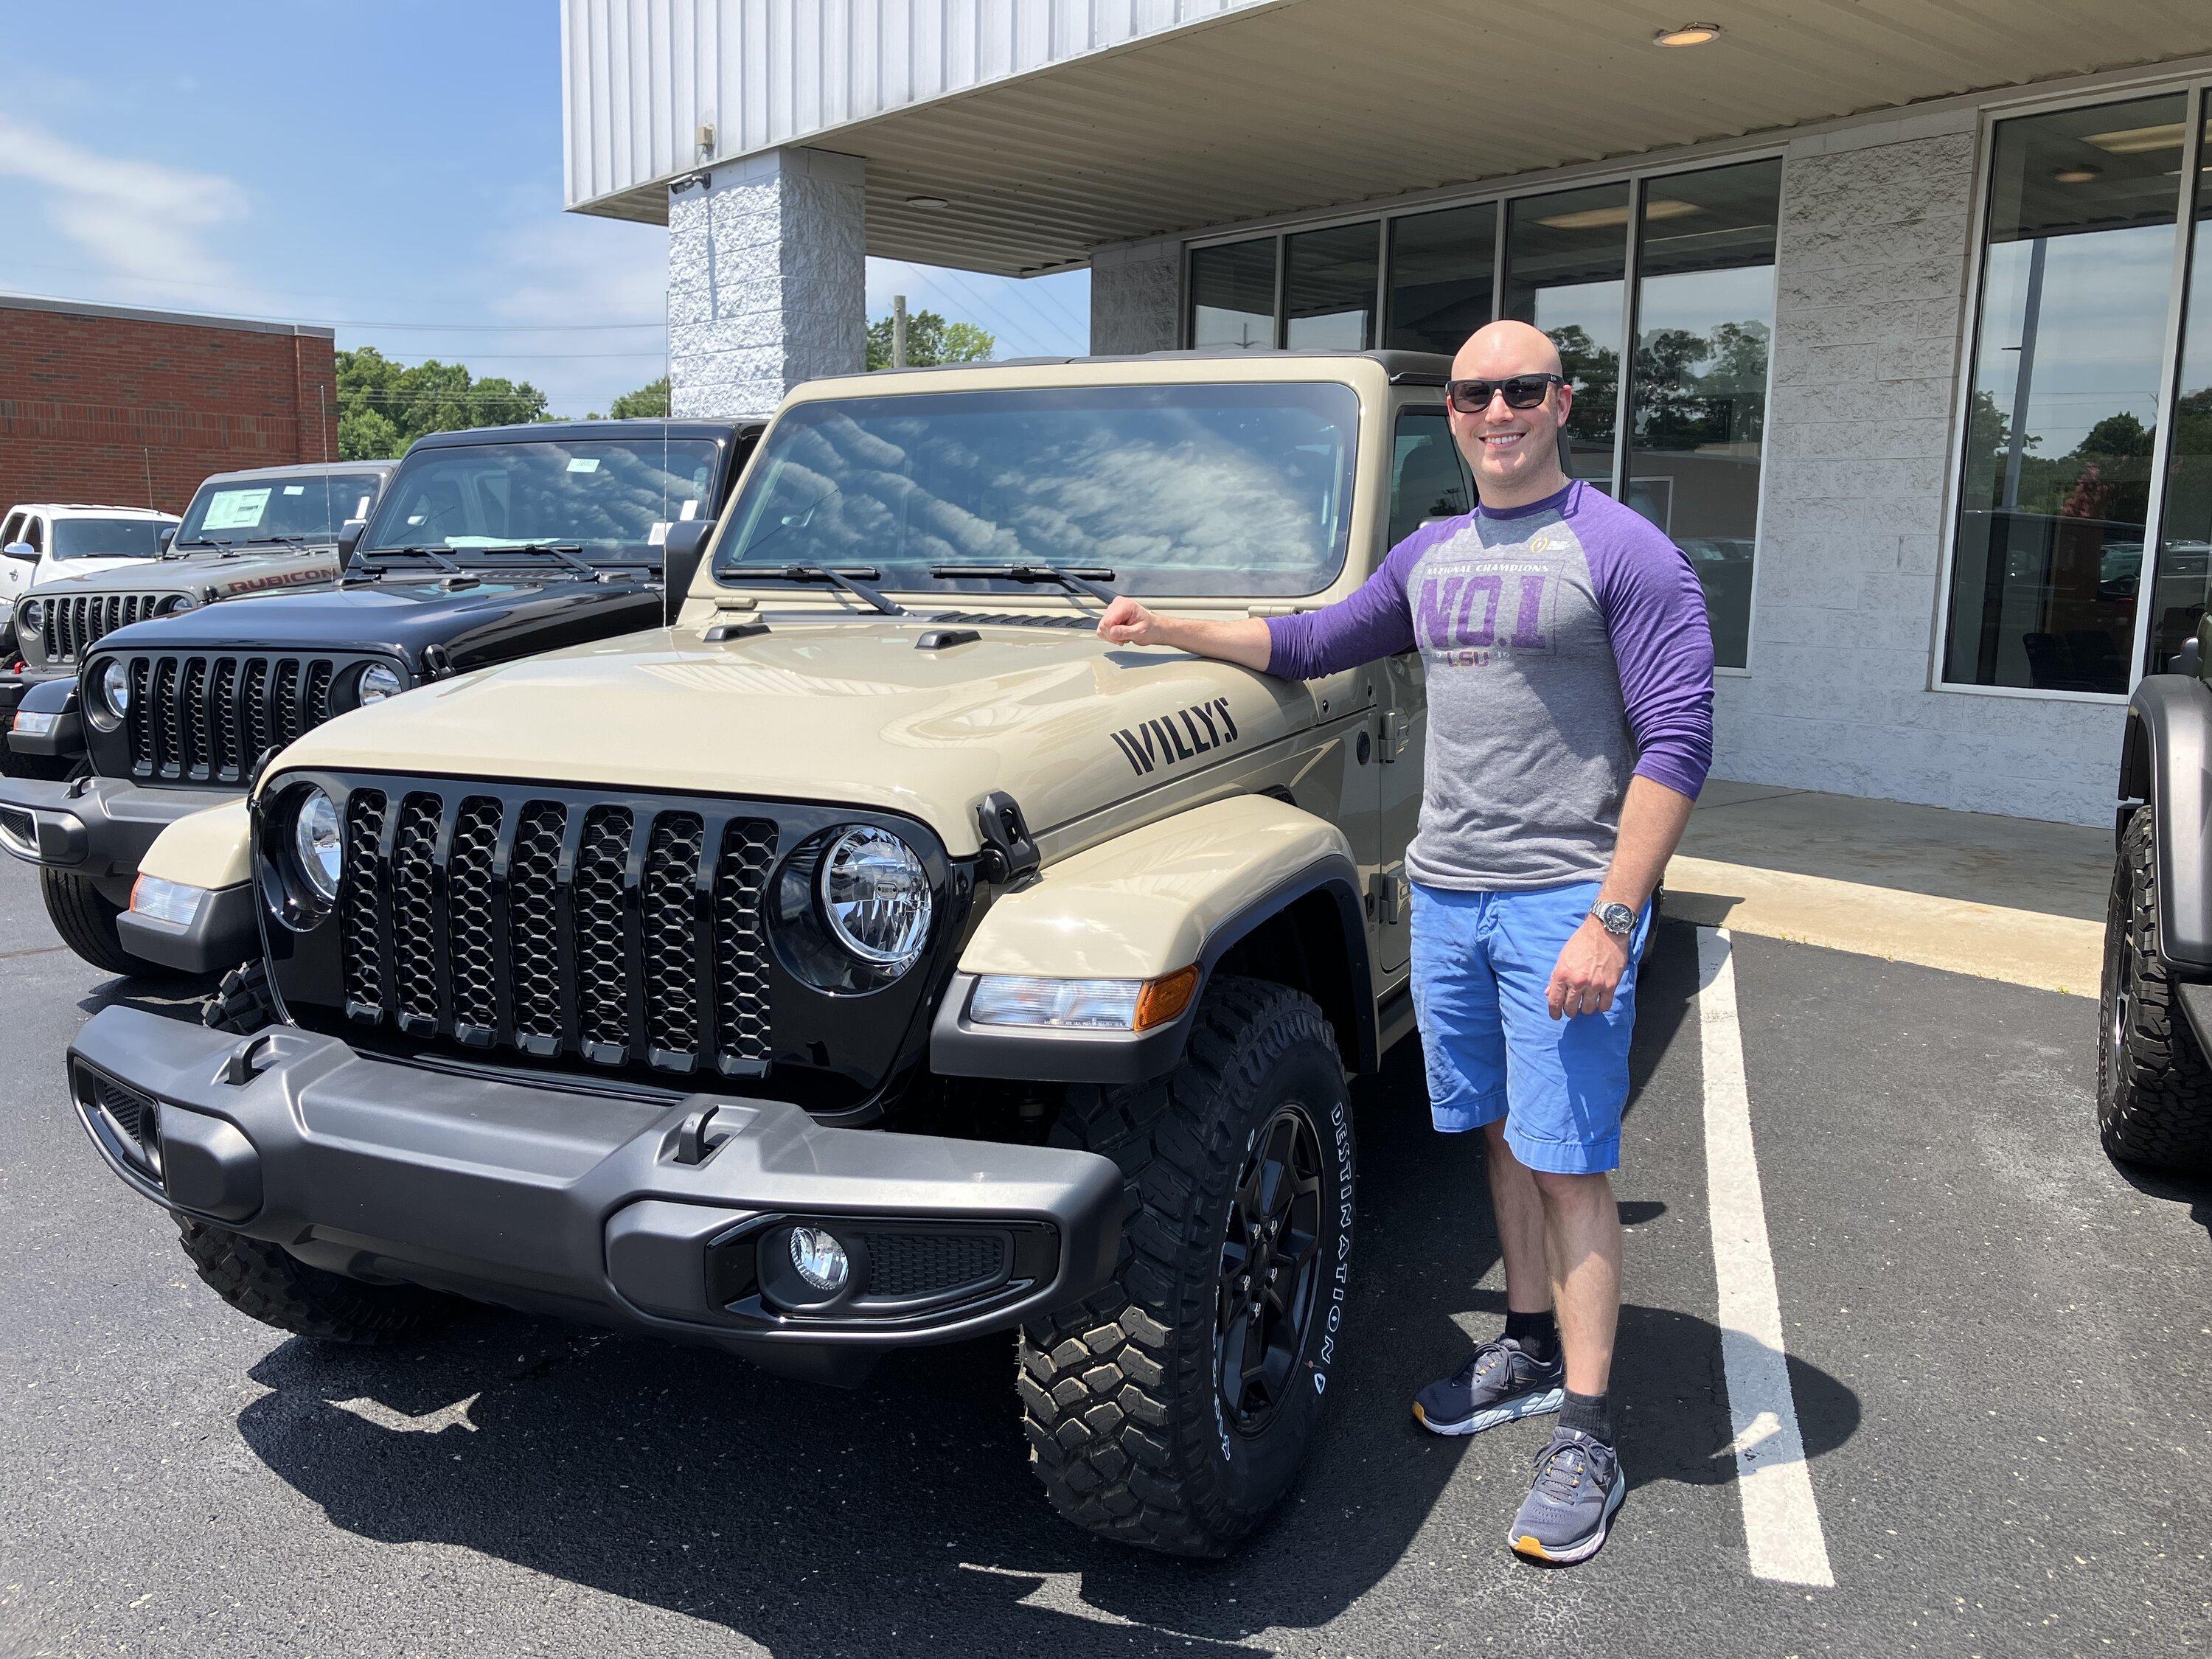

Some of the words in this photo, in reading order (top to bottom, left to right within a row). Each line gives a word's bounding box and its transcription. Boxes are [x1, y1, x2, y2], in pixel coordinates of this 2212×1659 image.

[227, 567, 338, 593] RUBICON
[1427, 565, 1472, 575] NATIONAL
[1475, 563, 1549, 573] CHAMPIONS
[1447, 650, 1490, 667] LSU
[1109, 697, 1239, 776] WILLYS
[1320, 1102, 1352, 1365] DESTINATION
